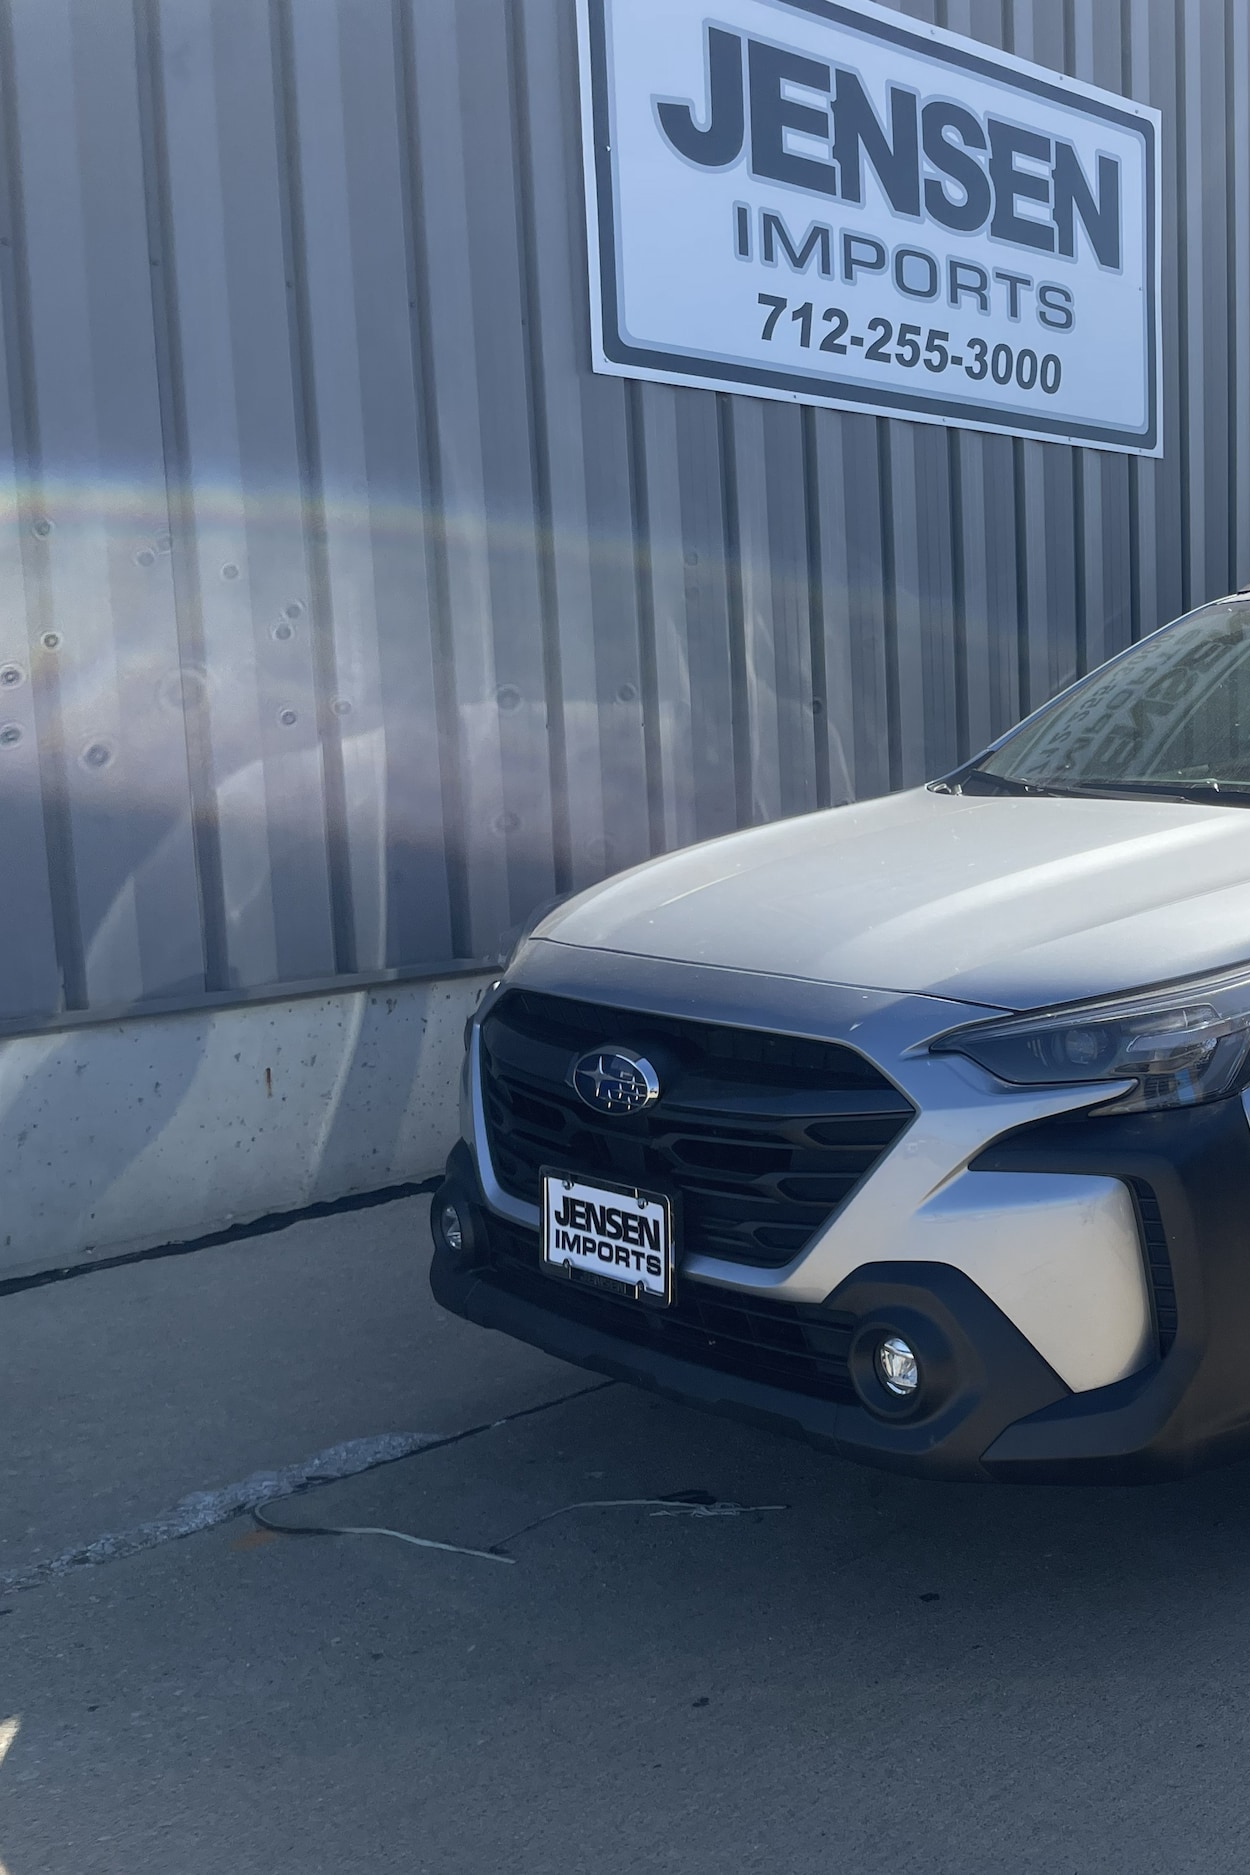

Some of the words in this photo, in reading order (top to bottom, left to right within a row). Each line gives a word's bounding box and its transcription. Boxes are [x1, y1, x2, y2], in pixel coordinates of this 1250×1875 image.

[655, 24, 1121, 271] JENSEN
[735, 204, 1074, 330] IMPORTS
[757, 292, 1062, 395] 712-255-3000
[554, 1195, 661, 1252] JENSEN
[555, 1229, 662, 1277] IMPORTS
